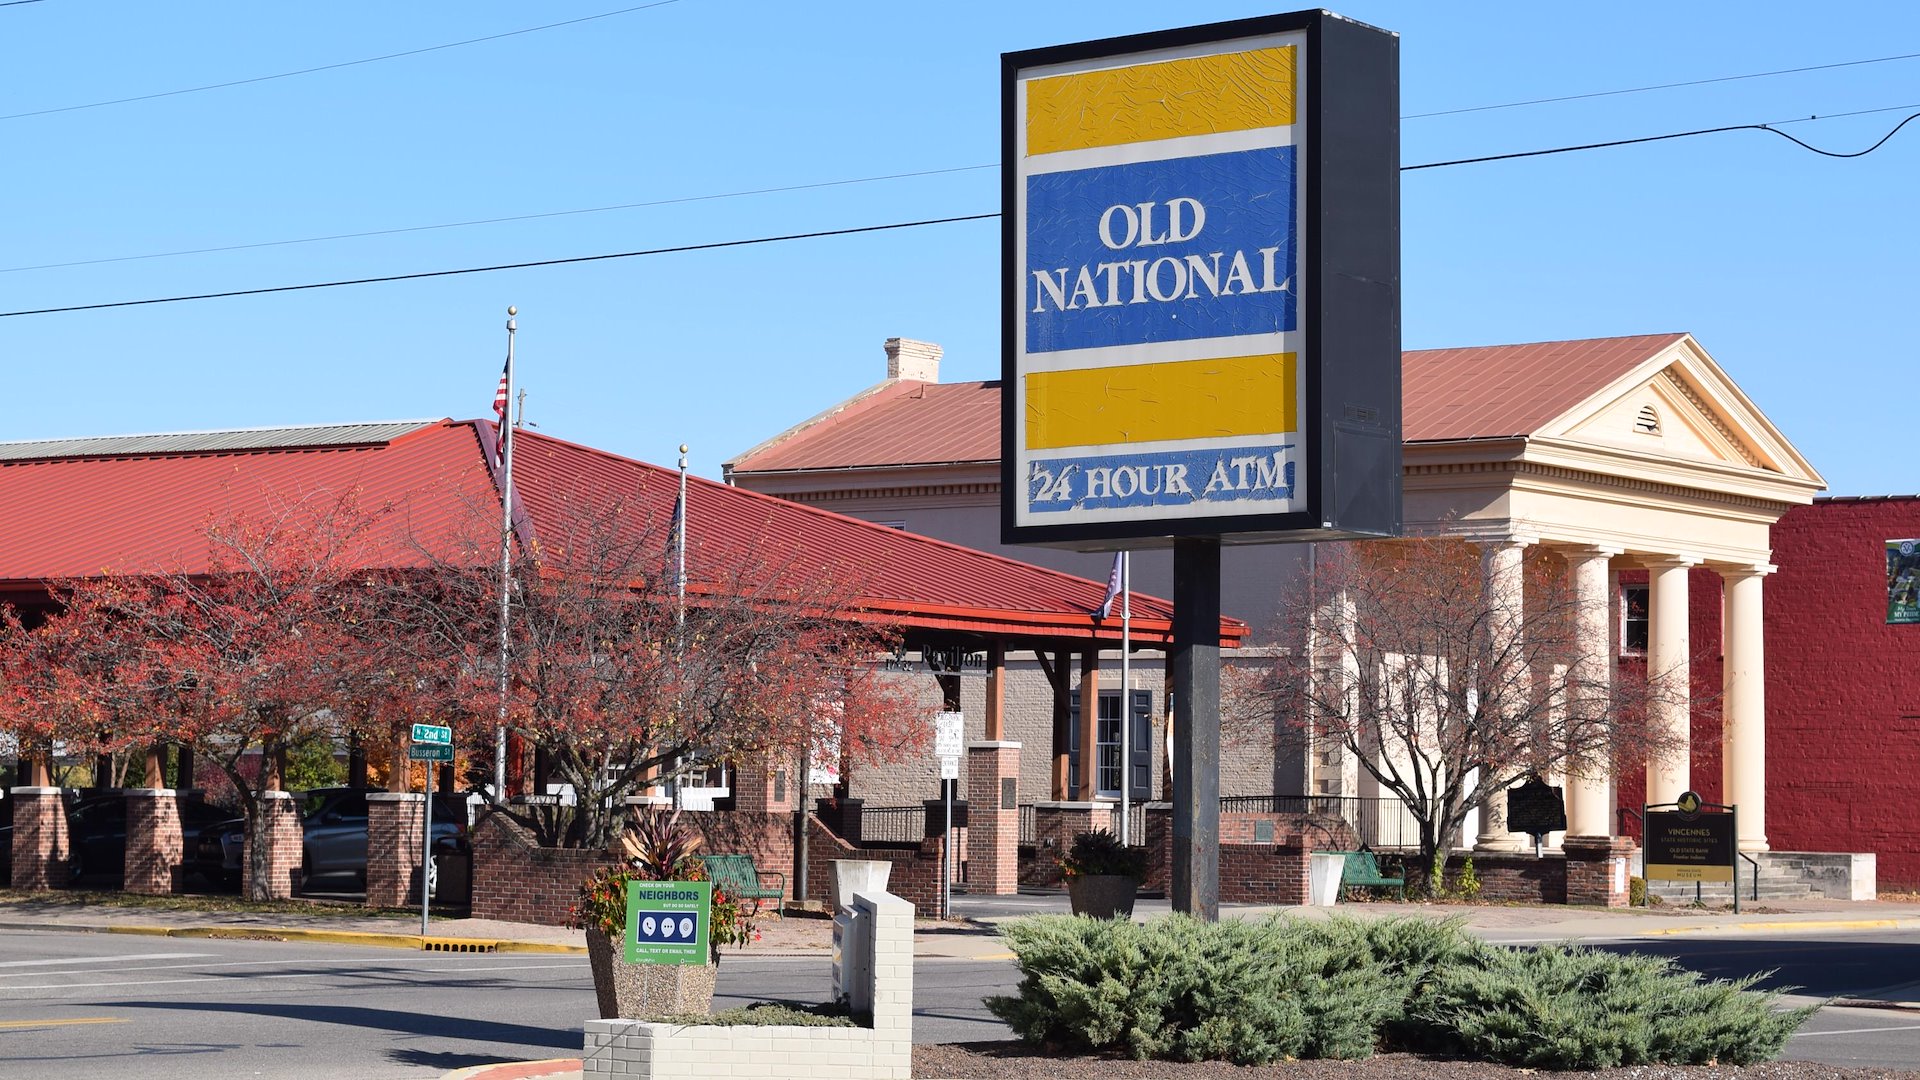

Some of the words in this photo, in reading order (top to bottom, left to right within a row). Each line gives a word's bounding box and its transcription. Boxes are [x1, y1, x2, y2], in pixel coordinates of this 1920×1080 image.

[1099, 197, 1206, 250] OLD
[1033, 247, 1290, 313] NATIONAL
[1030, 463, 1079, 501] 24
[1085, 463, 1192, 500] HOUR
[1202, 449, 1289, 497] ATM
[923, 645, 983, 667] Pavilion
[424, 729, 438, 740] 2nd
[441, 730, 448, 739] St
[411, 747, 440, 757] Busseron
[444, 748, 451, 756] St
[1668, 828, 1710, 836] VINCENNES
[639, 890, 699, 901] NEIGHBORS
